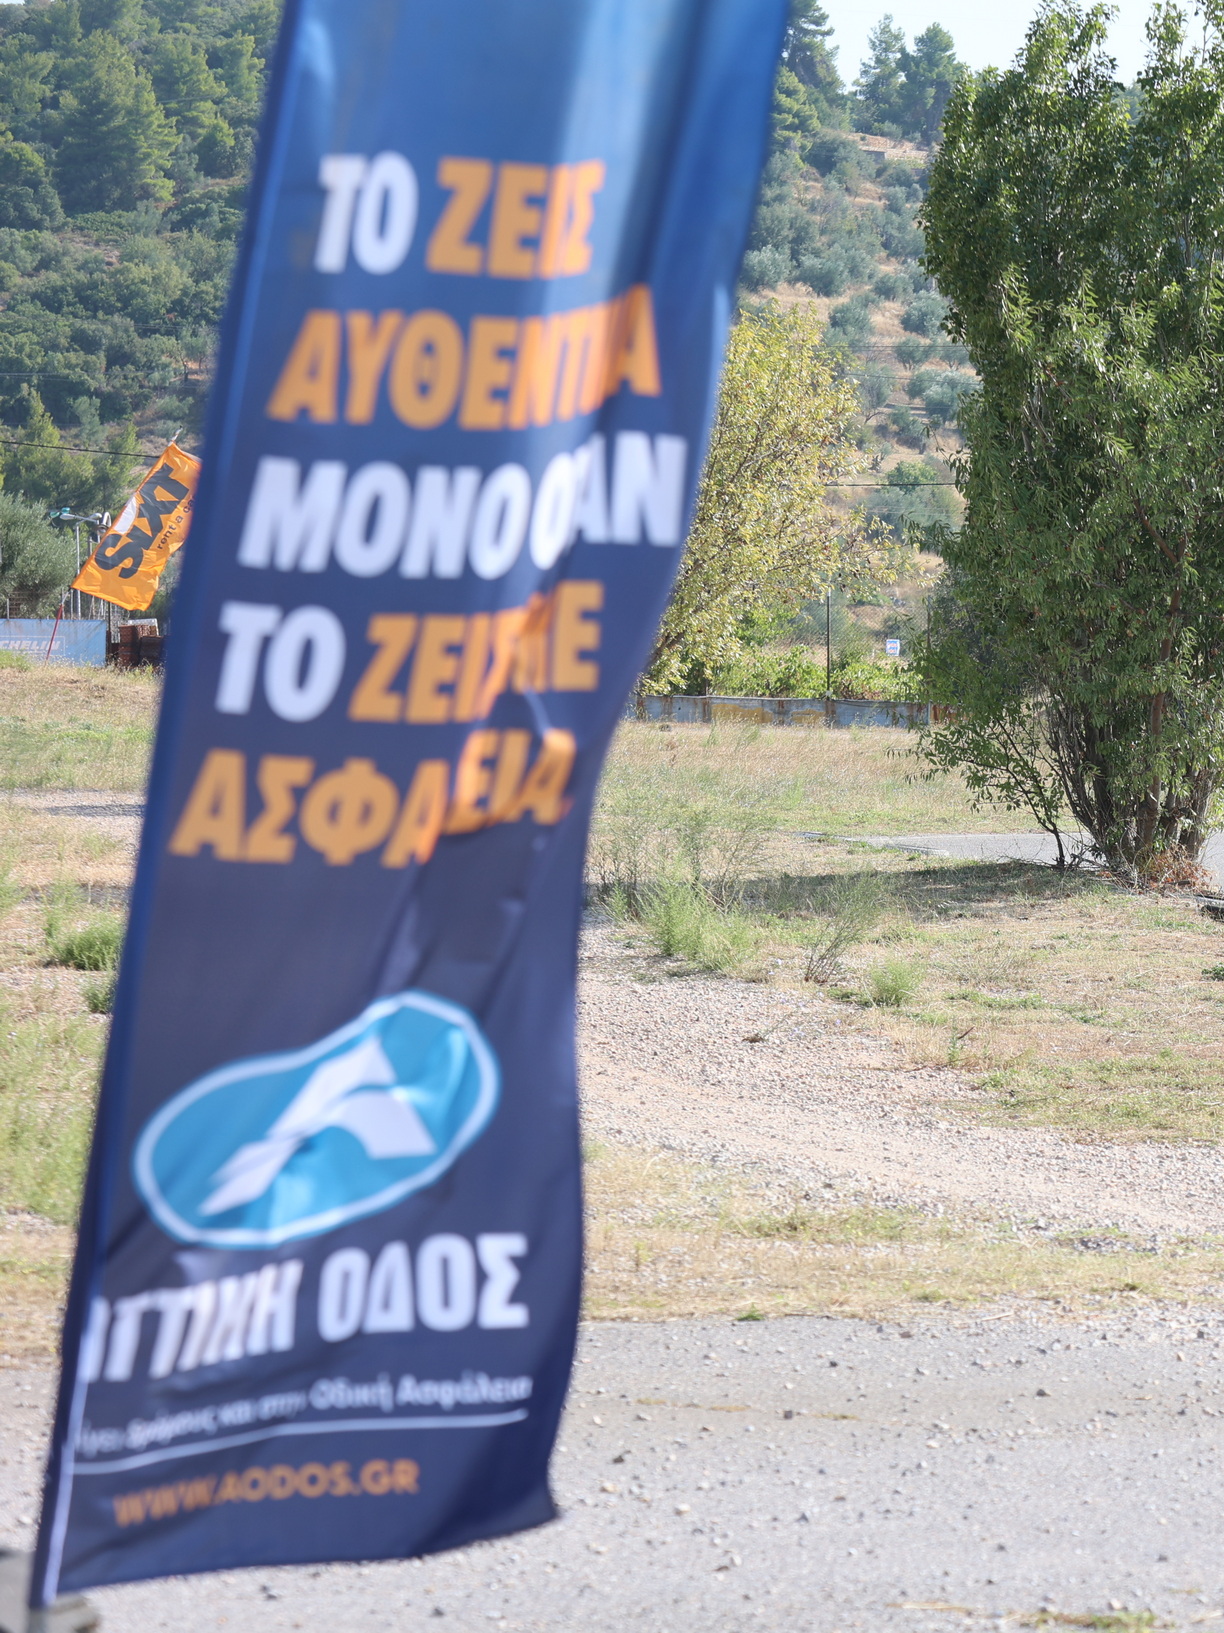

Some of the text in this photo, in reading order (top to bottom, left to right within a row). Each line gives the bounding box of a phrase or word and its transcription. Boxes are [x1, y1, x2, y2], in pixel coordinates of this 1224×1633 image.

[314, 151, 606, 279] ΤΟ ΖΕΙΣ
[94, 463, 190, 579] SIXT
[157, 524, 177, 550] rent
[175, 514, 184, 524] a
[237, 455, 532, 580] ΜΟΝΟ
[214, 600, 346, 722] ΤΟ
[317, 1233, 529, 1342] ΟΔΟΣ
[112, 1458, 420, 1528] WWWAODOS.GR
